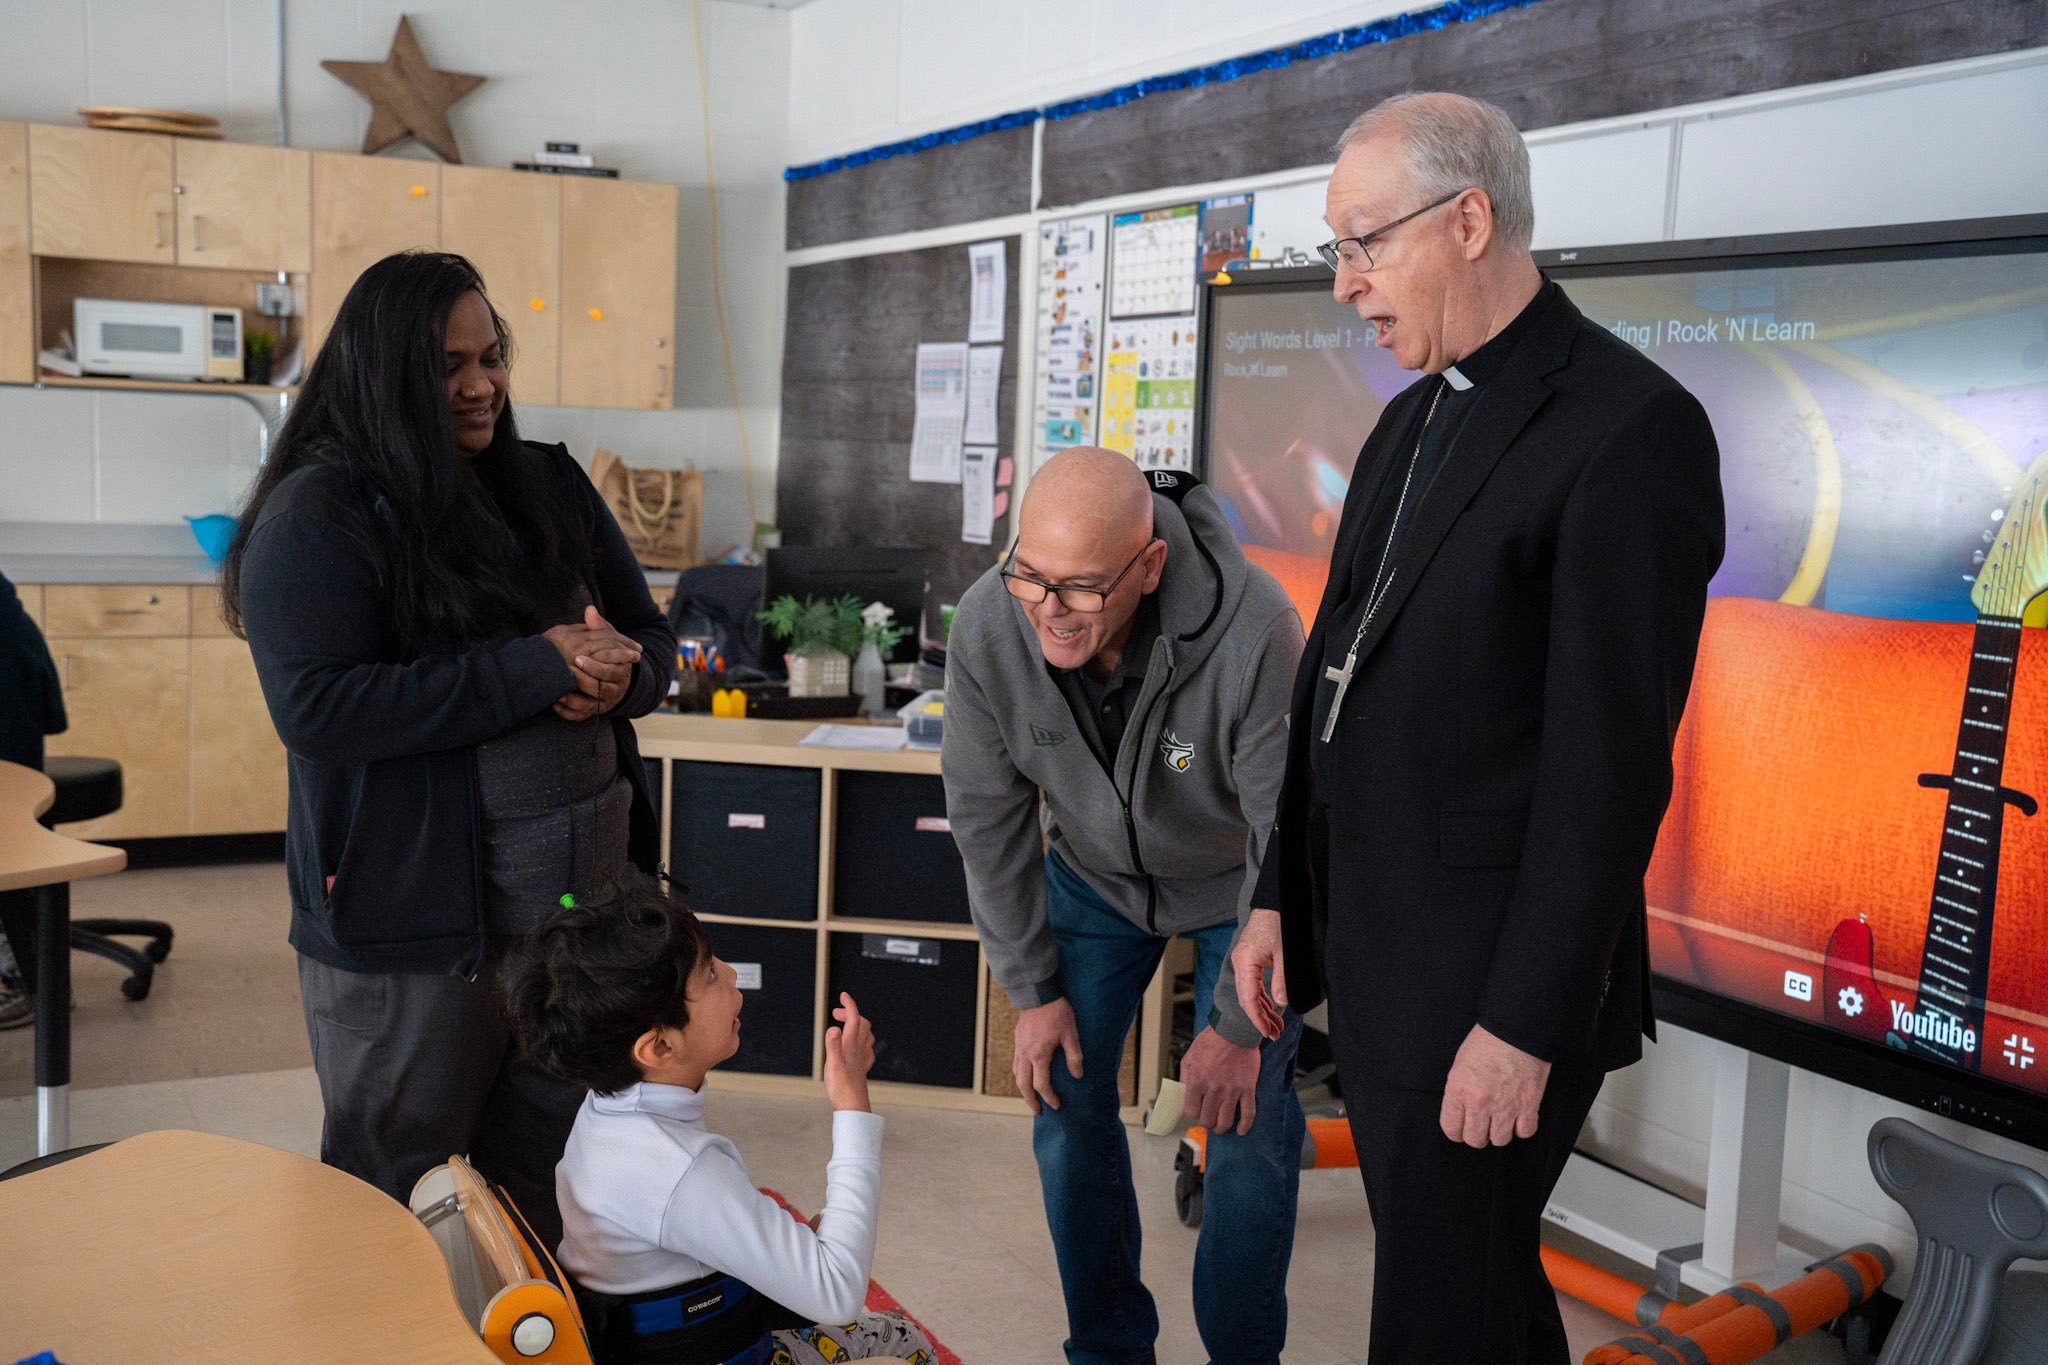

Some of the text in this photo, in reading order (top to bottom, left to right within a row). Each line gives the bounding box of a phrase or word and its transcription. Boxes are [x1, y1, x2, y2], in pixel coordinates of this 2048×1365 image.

[1226, 331, 1257, 354] Sight
[1261, 330, 1301, 349] Words
[1305, 328, 1340, 349] Level
[1345, 329, 1351, 348] 1
[1610, 319, 1650, 348] ding
[1667, 319, 1718, 342] Rock
[1725, 317, 1746, 342] 'N
[1752, 319, 1815, 342] Learn
[1789, 979, 1807, 993] CC
[1891, 1000, 1976, 1052] YouTube
